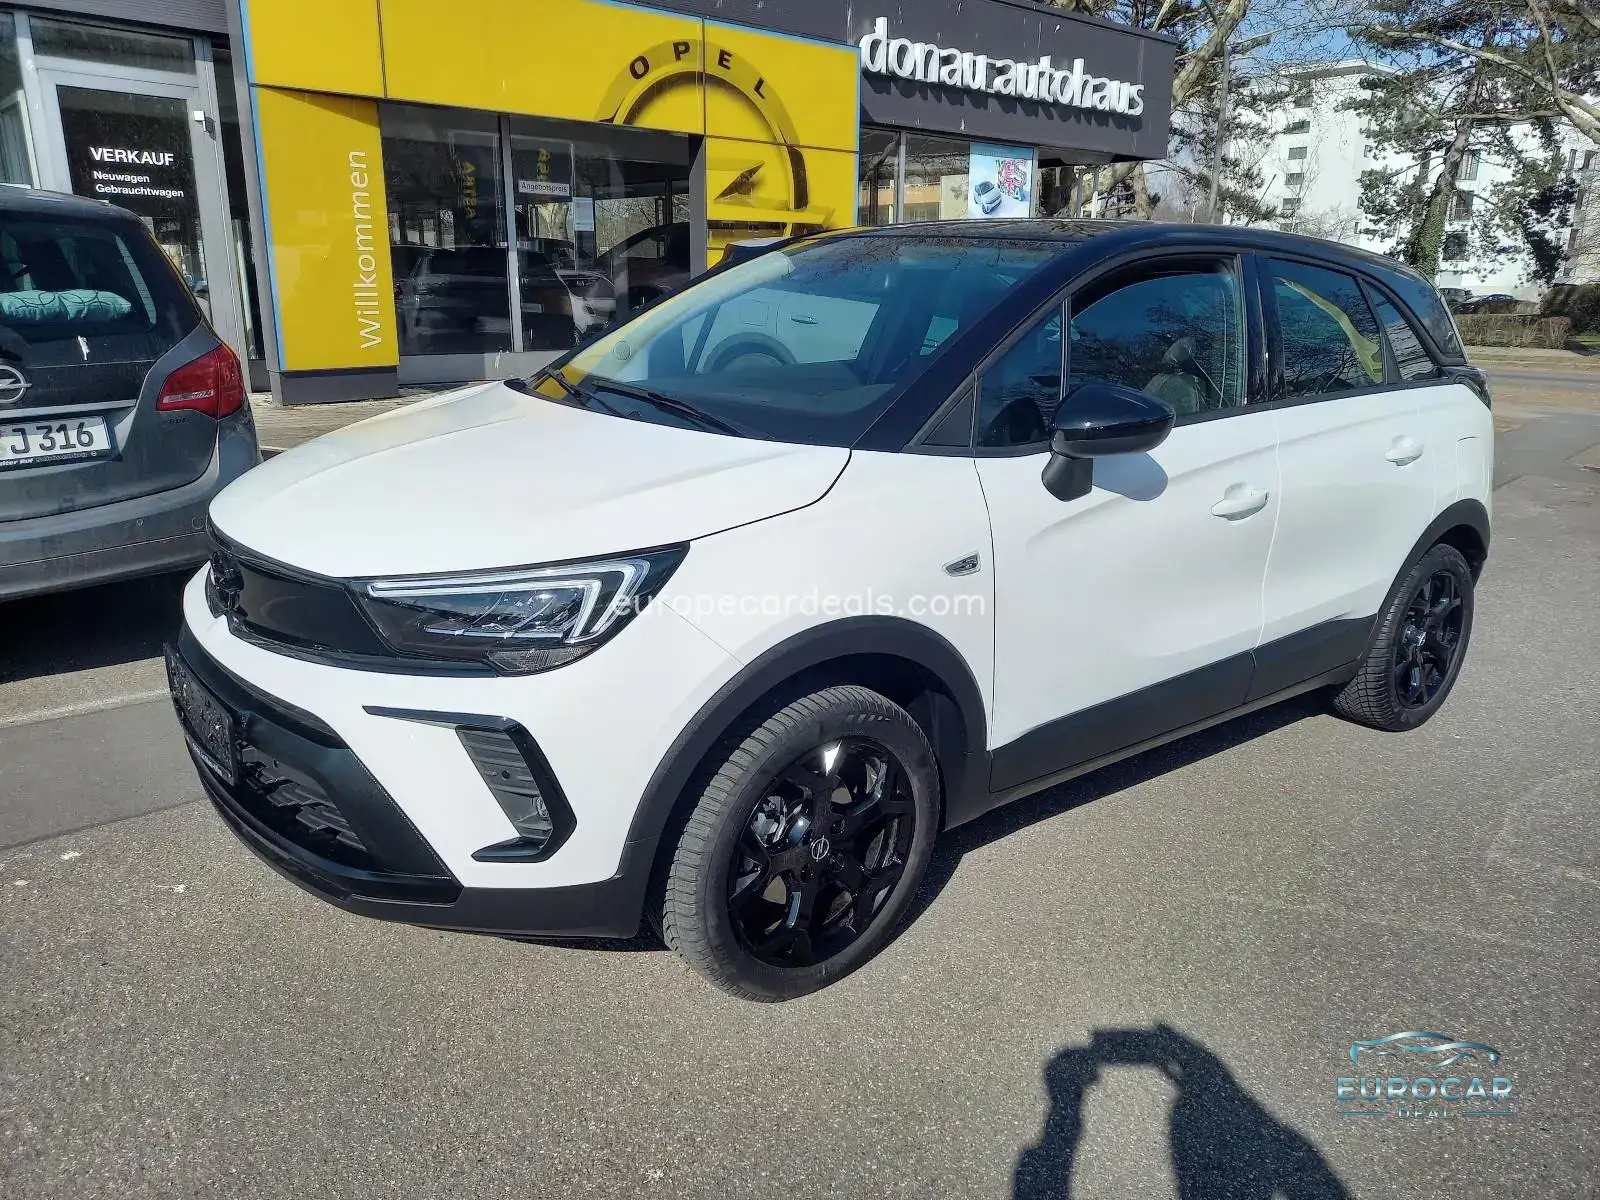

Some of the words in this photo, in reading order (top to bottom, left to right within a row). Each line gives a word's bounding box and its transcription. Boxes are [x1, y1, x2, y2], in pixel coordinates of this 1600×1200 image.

[629, 41, 765, 99] OPEL
[89, 146, 174, 167] VERKAUF
[93, 170, 150, 184] Neuwagen
[95, 183, 185, 199] Gebrauchtwagen
[10, 427, 31, 455] J
[36, 422, 94, 452] 316
